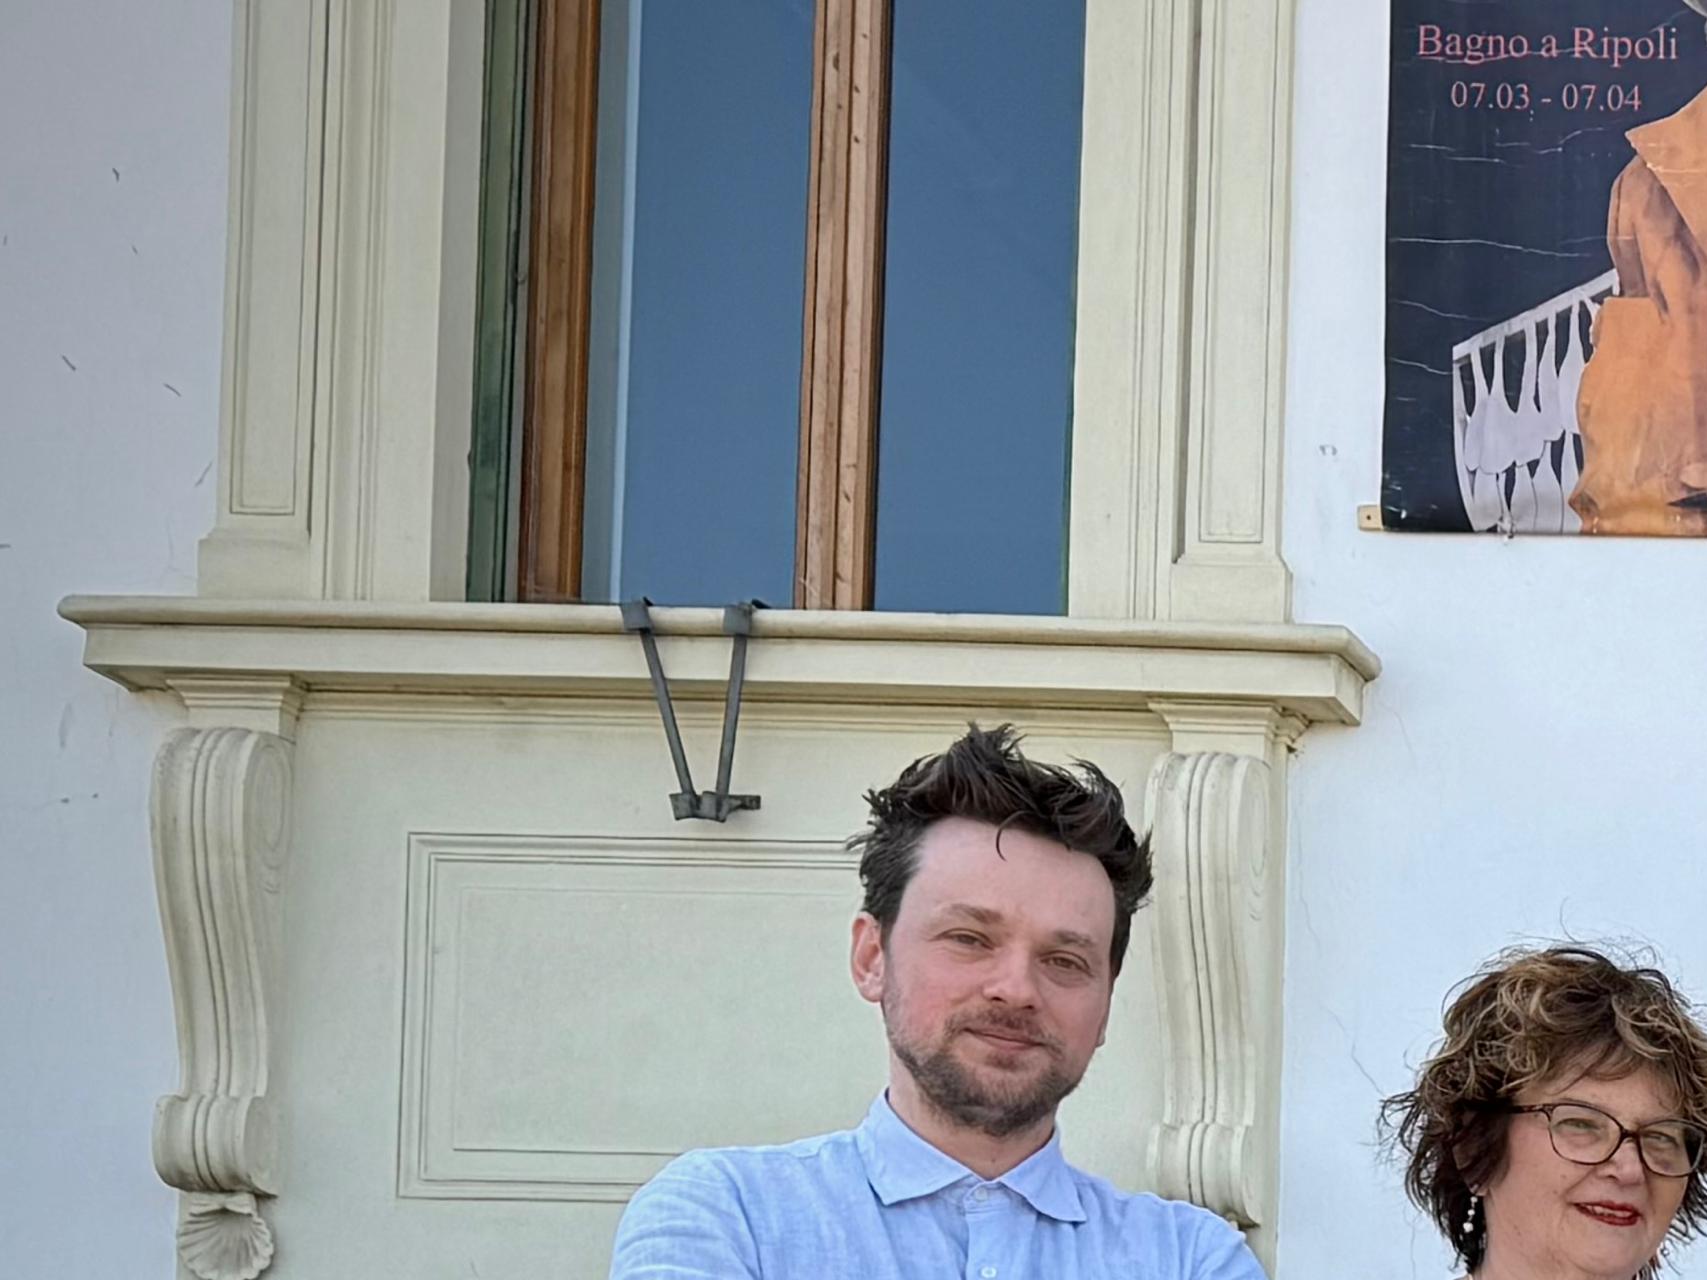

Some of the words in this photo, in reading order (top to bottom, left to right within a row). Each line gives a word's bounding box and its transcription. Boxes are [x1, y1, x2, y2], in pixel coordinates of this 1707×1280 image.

[1416, 24, 1528, 64] Bagno
[1541, 34, 1558, 58] a
[1572, 26, 1678, 68] Ripoli
[1451, 81, 1530, 110] 07.03
[1562, 82, 1642, 112] 07.04
